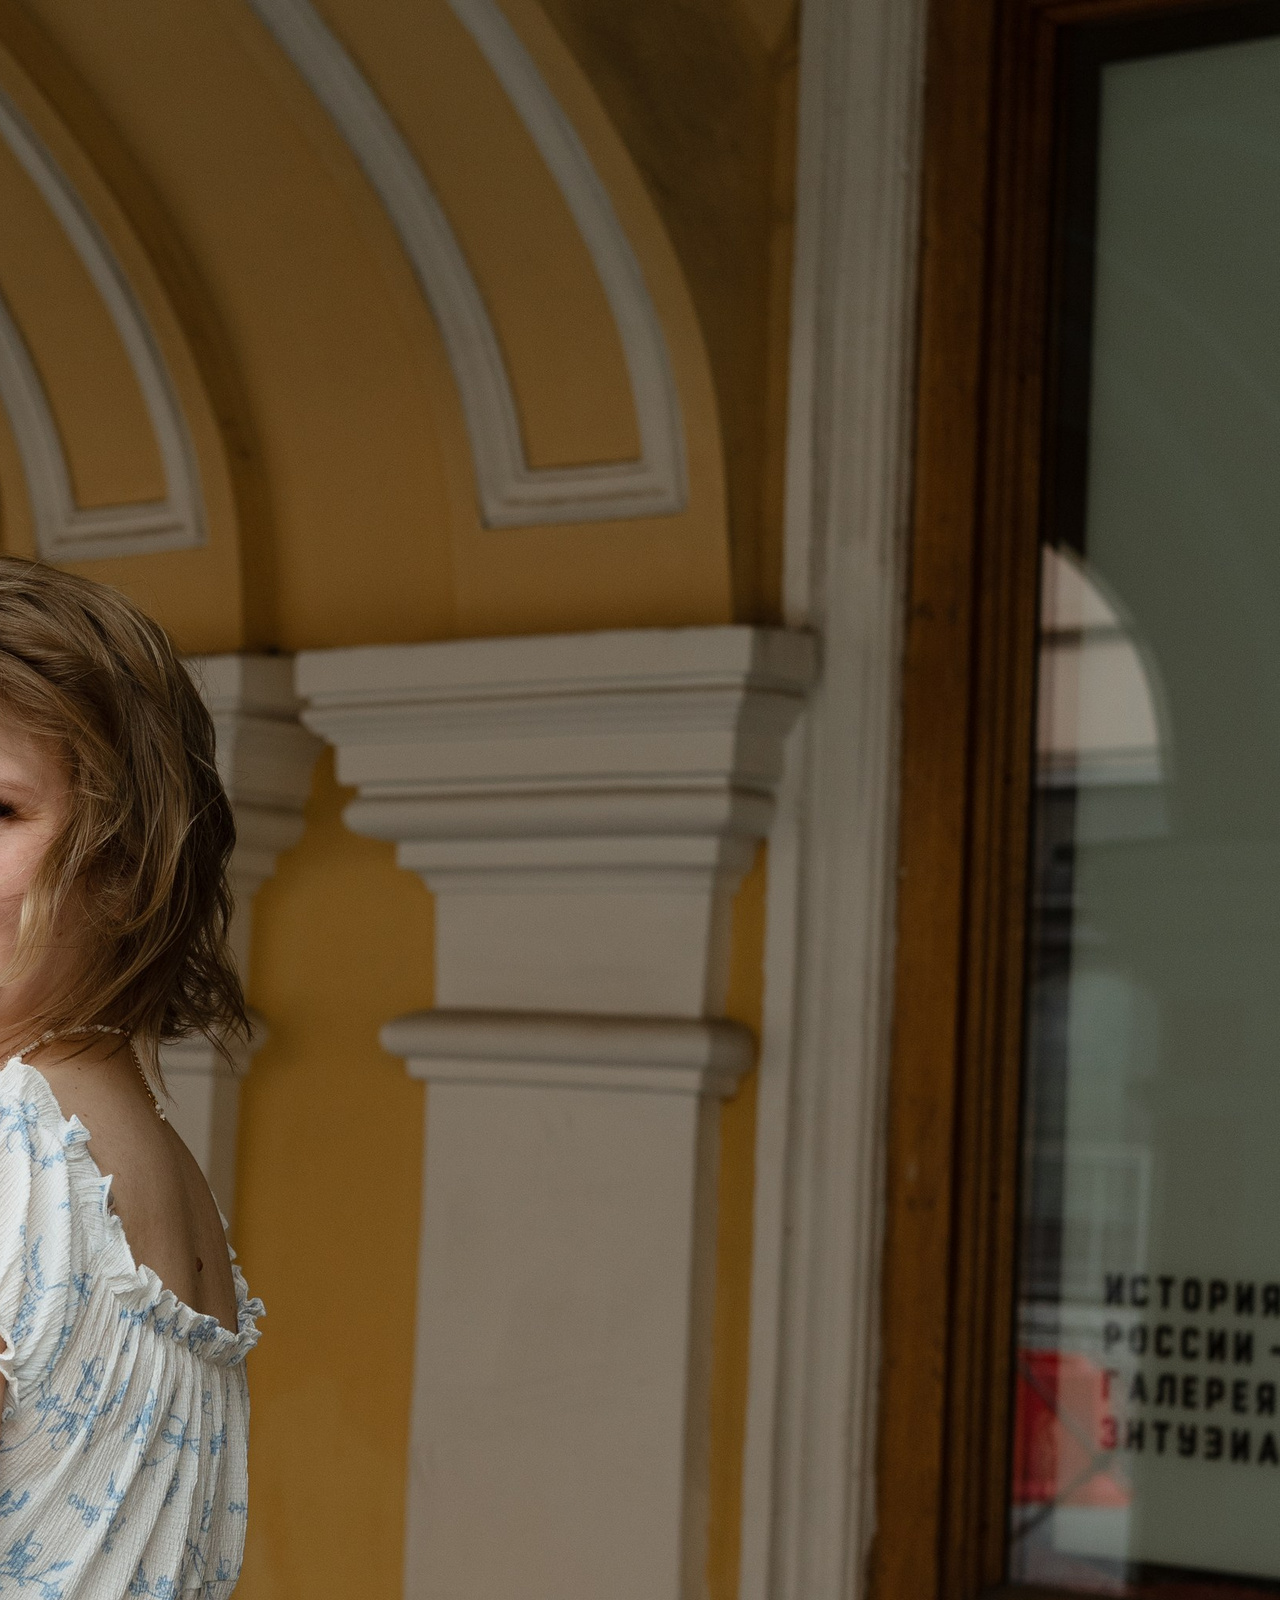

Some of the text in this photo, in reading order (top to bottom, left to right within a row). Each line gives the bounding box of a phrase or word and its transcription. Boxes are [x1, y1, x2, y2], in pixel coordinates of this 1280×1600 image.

[1104, 1273, 1280, 1318] ИСТОРИЯ
[1104, 1321, 1254, 1367] РОССИИ
[1101, 1368, 1277, 1417] ГАЛЕРЕЯ
